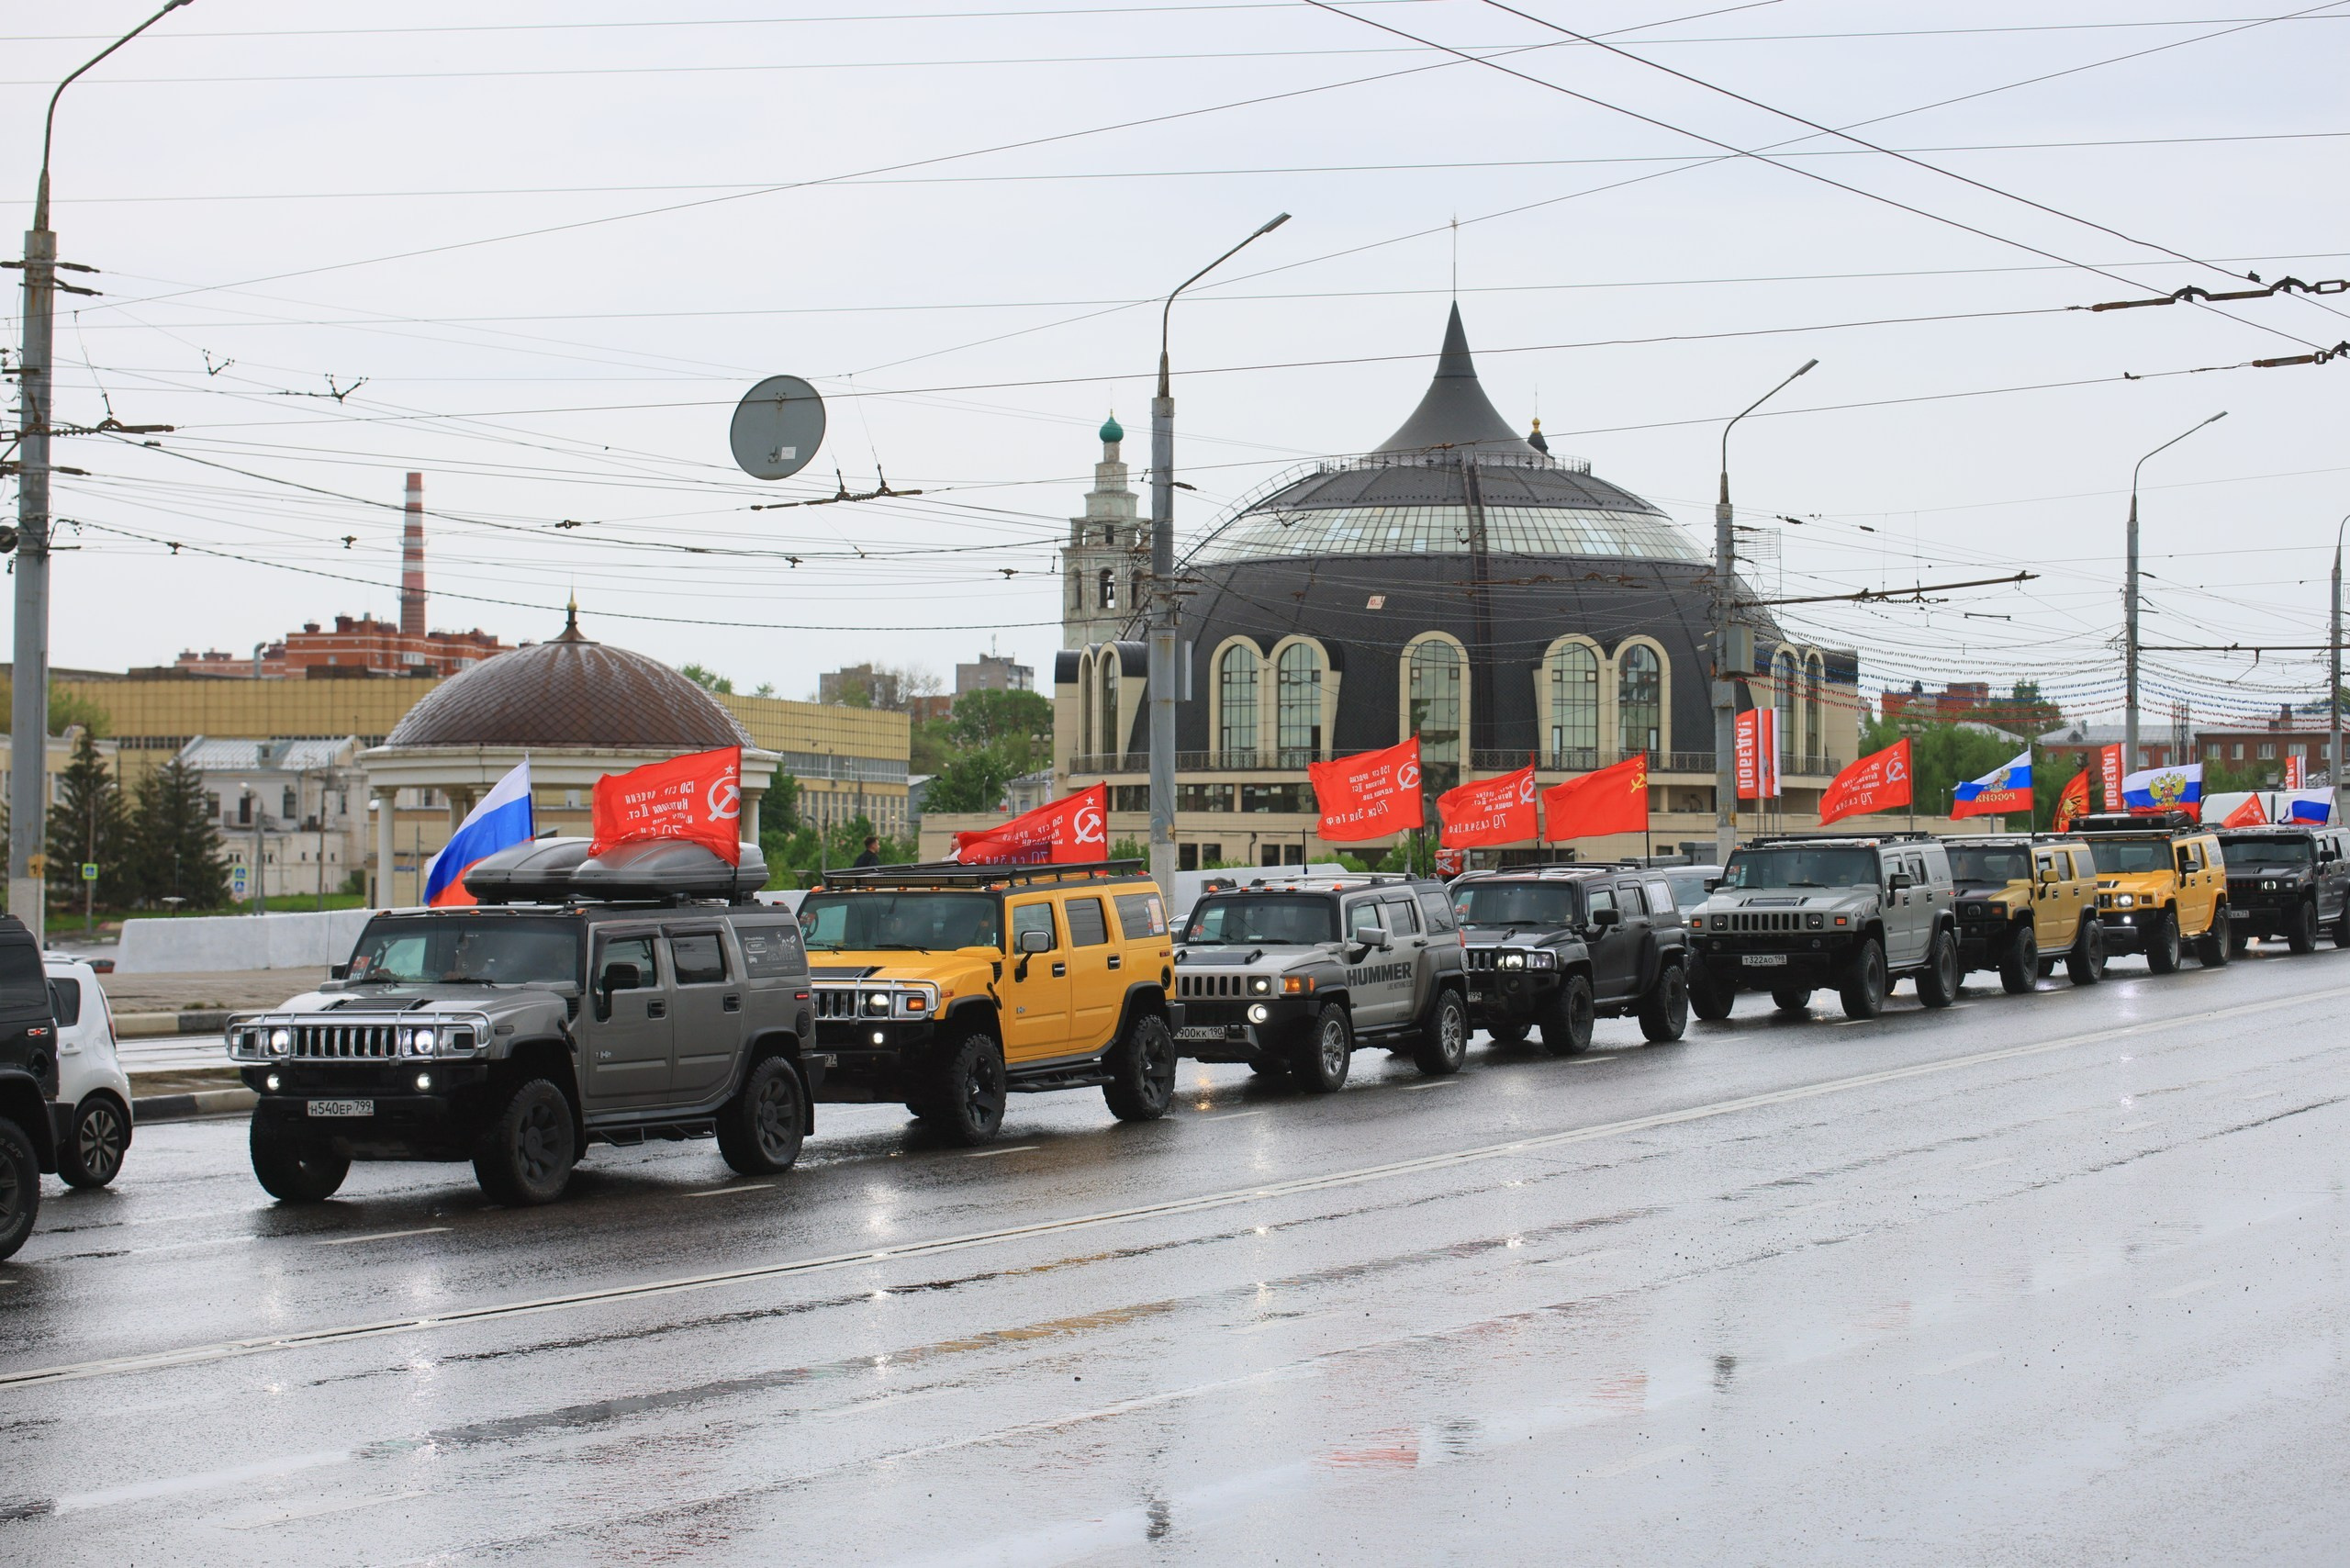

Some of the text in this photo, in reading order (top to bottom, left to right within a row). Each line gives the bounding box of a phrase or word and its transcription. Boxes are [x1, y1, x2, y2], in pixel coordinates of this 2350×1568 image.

[1346, 961, 1412, 987] HUMMER
[1176, 1028, 1207, 1037] 900КК
[311, 1102, 371, 1114] Н540ЕР 799
